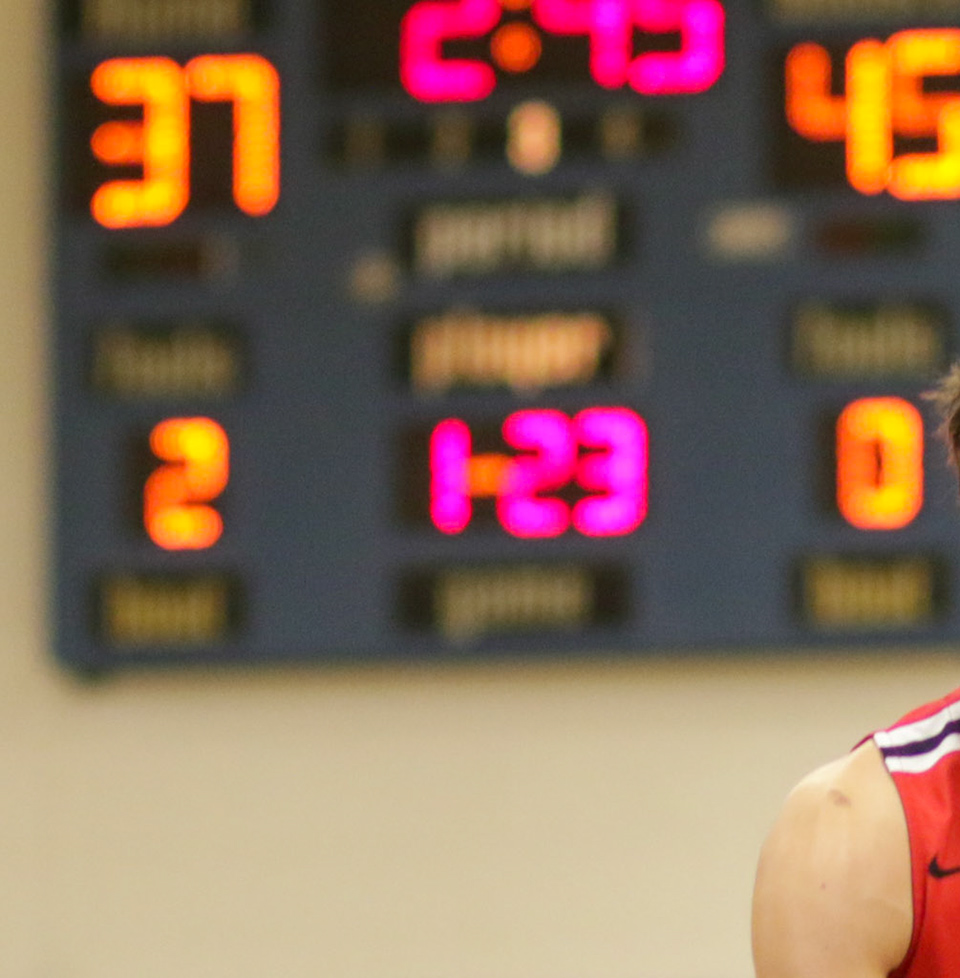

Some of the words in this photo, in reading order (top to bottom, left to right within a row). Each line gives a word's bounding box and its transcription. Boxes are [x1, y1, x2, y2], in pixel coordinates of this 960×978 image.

[400, 0, 726, 103] 2:45
[91, 53, 281, 229] 37
[143, 416, 230, 551] 2
[836, 396, 924, 531] 0
